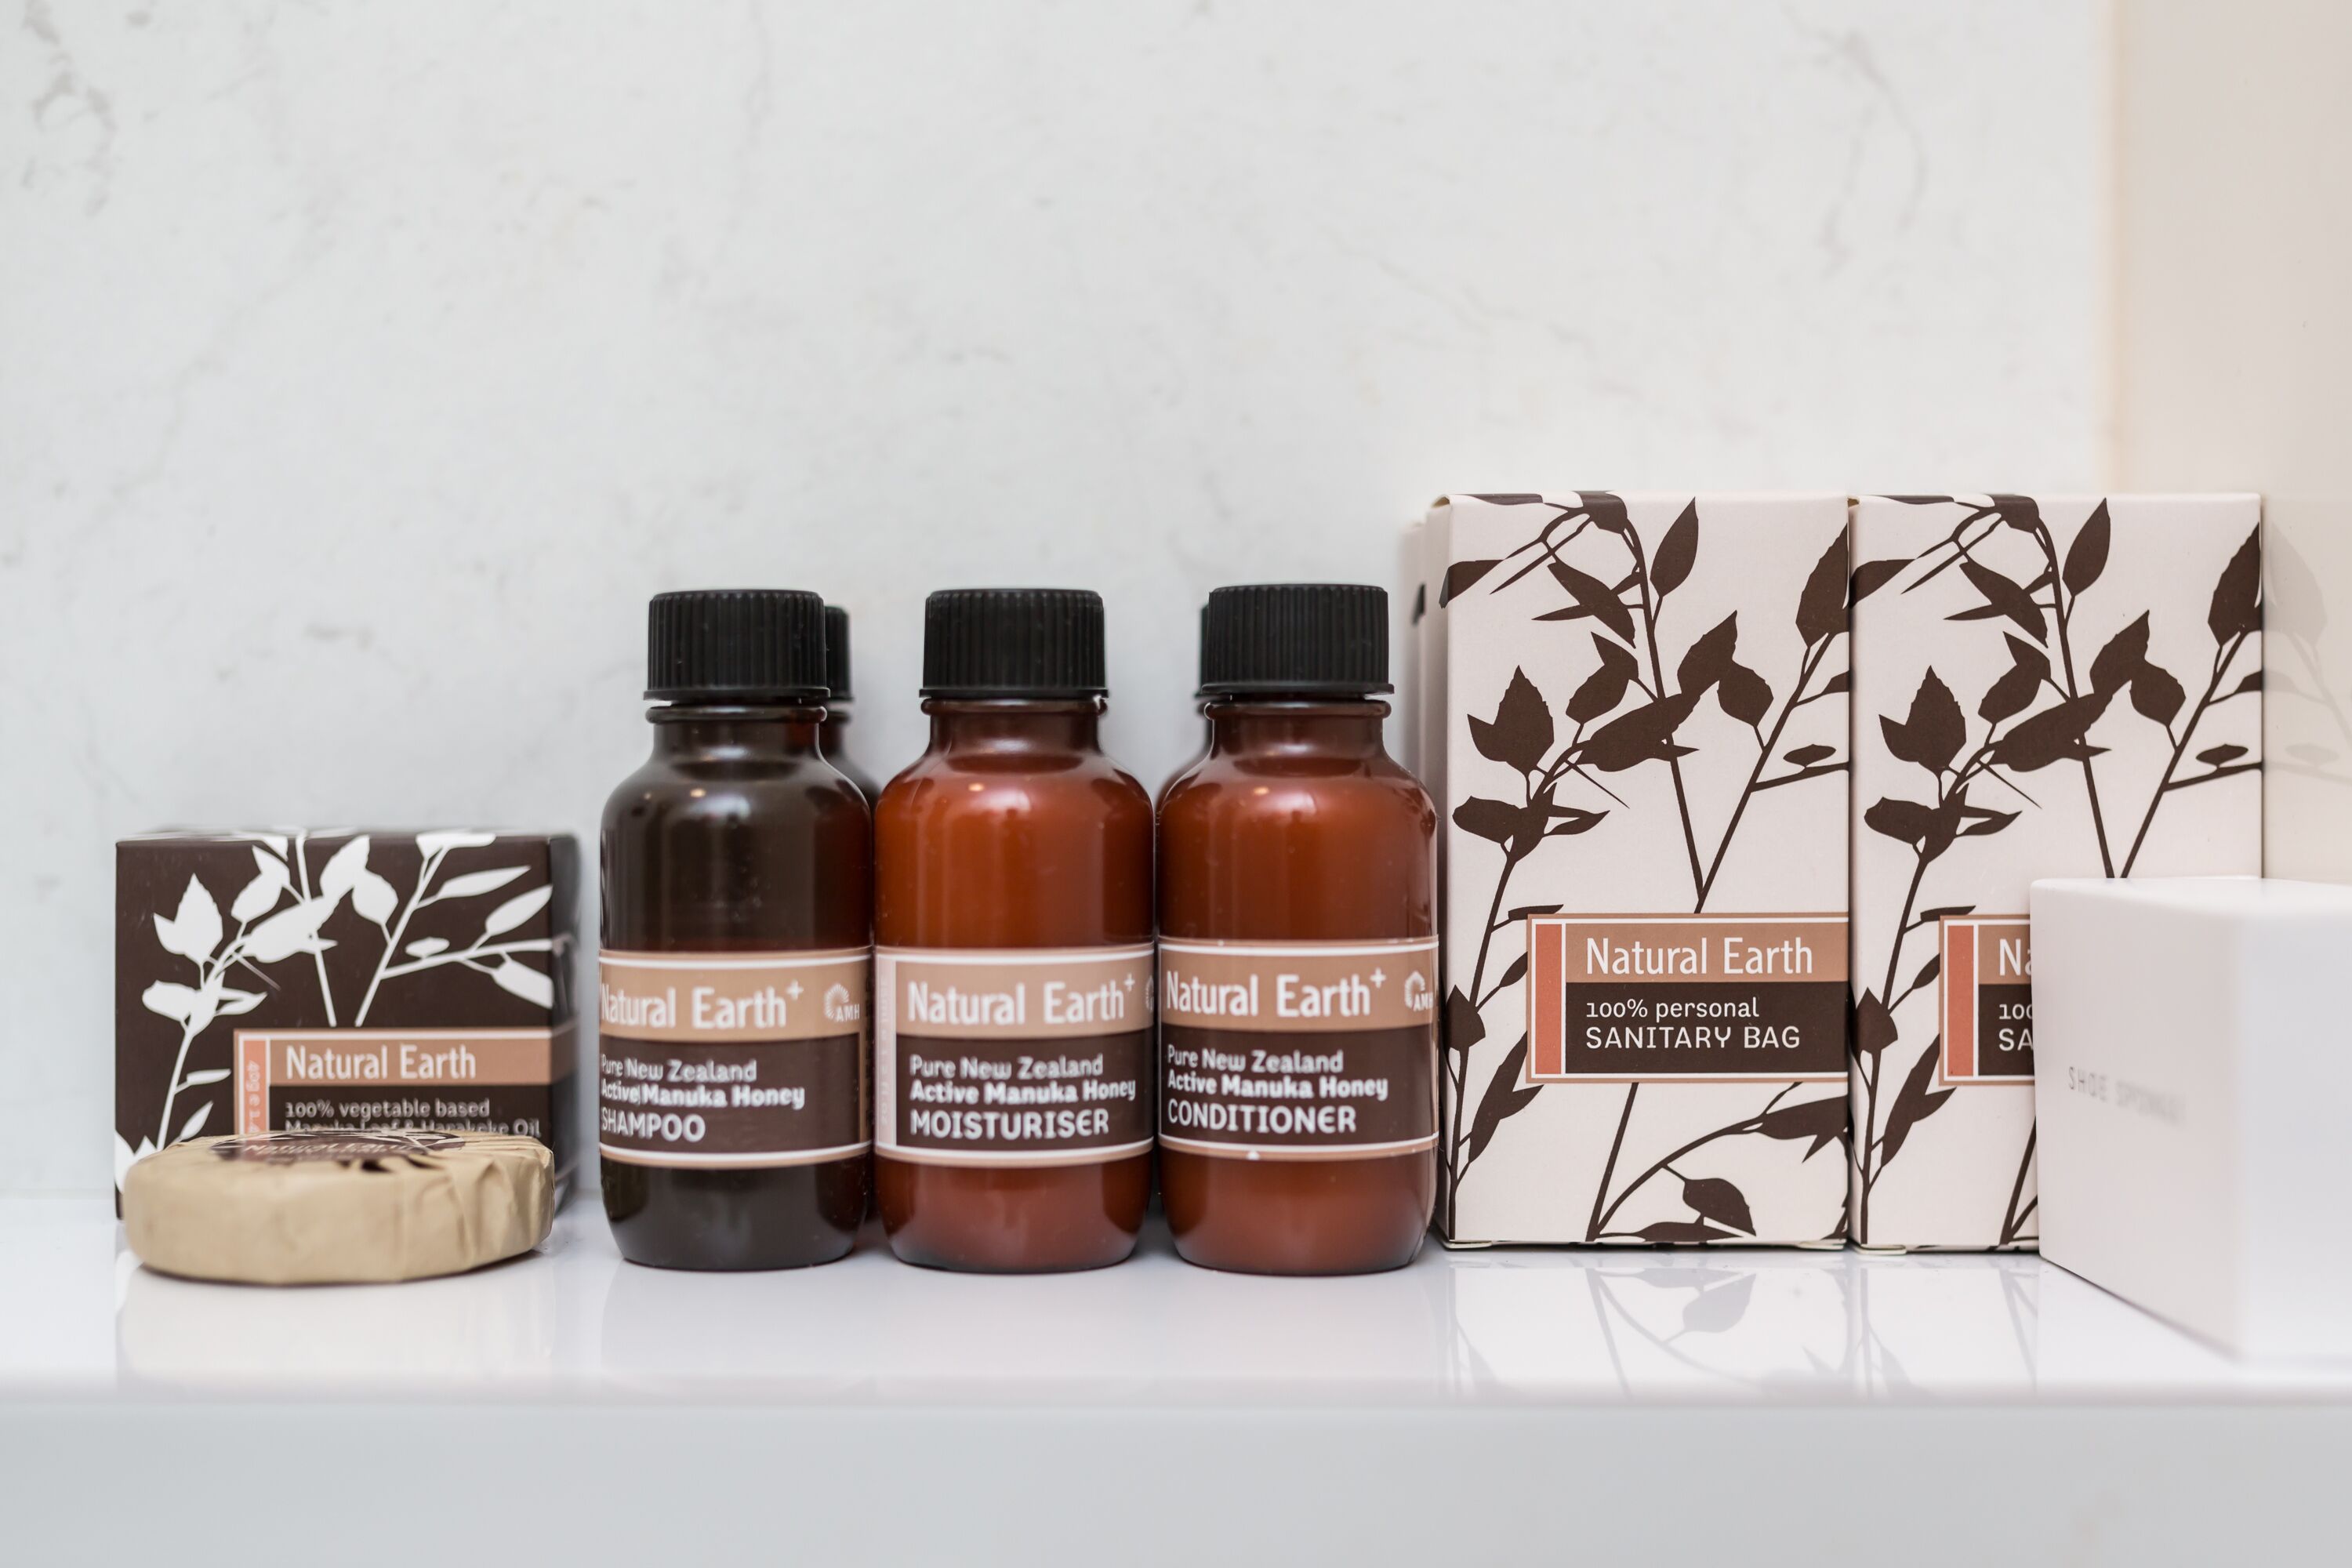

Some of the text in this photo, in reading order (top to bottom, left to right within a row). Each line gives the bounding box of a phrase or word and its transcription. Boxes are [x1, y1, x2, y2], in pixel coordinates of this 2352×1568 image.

[1586, 937, 1813, 975] Natural Earth
[601, 983, 676, 1028] Natural
[908, 981, 1025, 1025] Natural
[1167, 971, 1258, 1017] Natural
[1586, 996, 1759, 1022] 100% personal
[835, 1004, 860, 1022] AMH
[1586, 1026, 1800, 1050] SANITARY BAG
[286, 1044, 477, 1080] Natural Earth
[601, 1054, 757, 1083] Pure New Zealand
[909, 1054, 1104, 1080] Pure New Zealand
[1167, 1044, 1344, 1073] Pure New Zealand
[601, 1078, 806, 1110] Active Manuka Honey
[910, 1080, 1136, 1105] Active Manuka Honey
[1167, 1069, 1388, 1101] Active Manuka Honey
[285, 1098, 490, 1123] 100% vegetable based
[601, 1107, 706, 1142] SHAMPOO
[910, 1108, 1109, 1140] MOISTURISER
[1167, 1098, 1357, 1134] CONDITIONER
[513, 1118, 541, 1137] Oil
